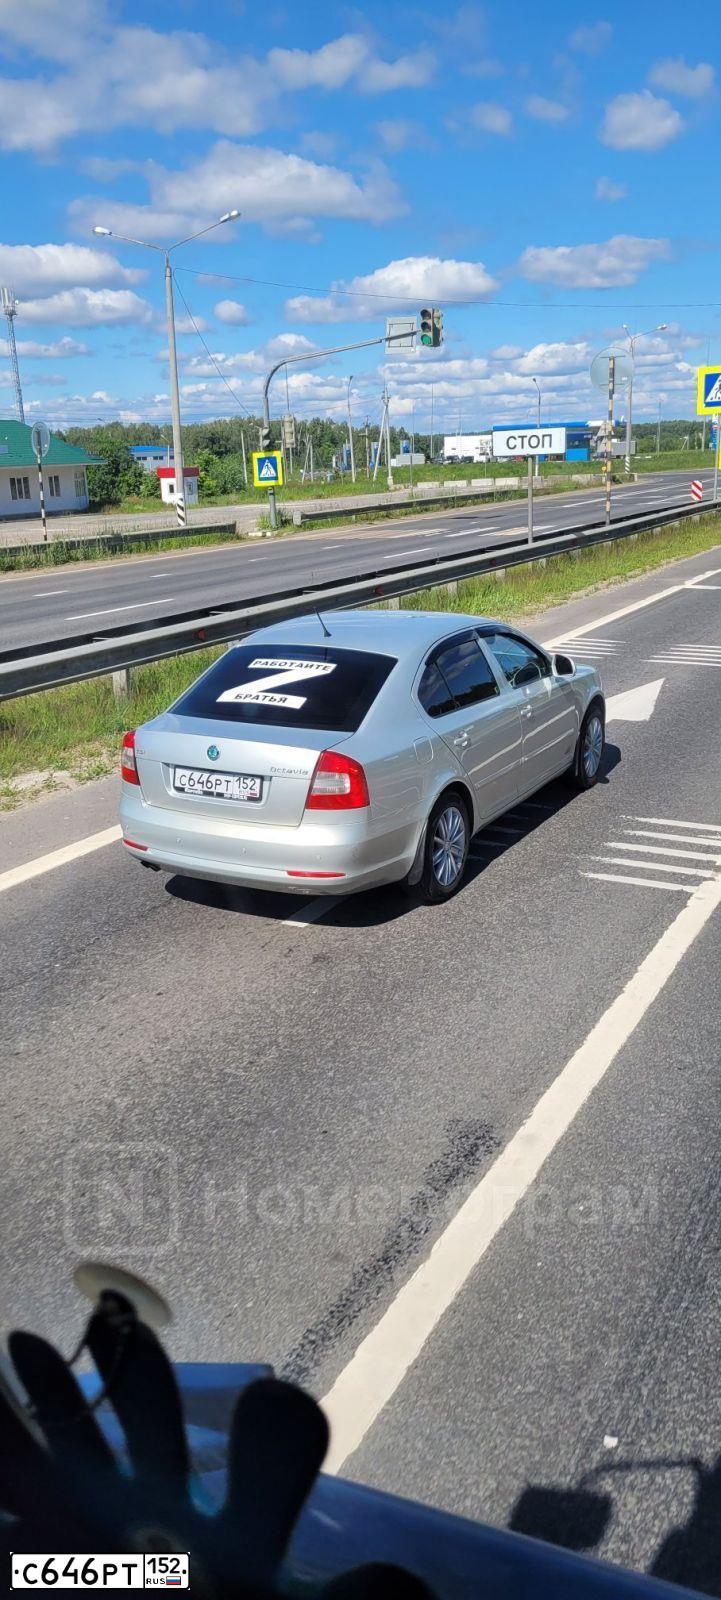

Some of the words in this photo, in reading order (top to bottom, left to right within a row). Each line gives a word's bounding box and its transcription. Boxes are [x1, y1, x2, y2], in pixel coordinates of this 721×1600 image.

[506, 434, 552, 450] СТОП
[234, 693, 289, 704] БРАТЬЯ
[270, 766, 309, 775] Octavia
[235, 777, 256, 790] 152
